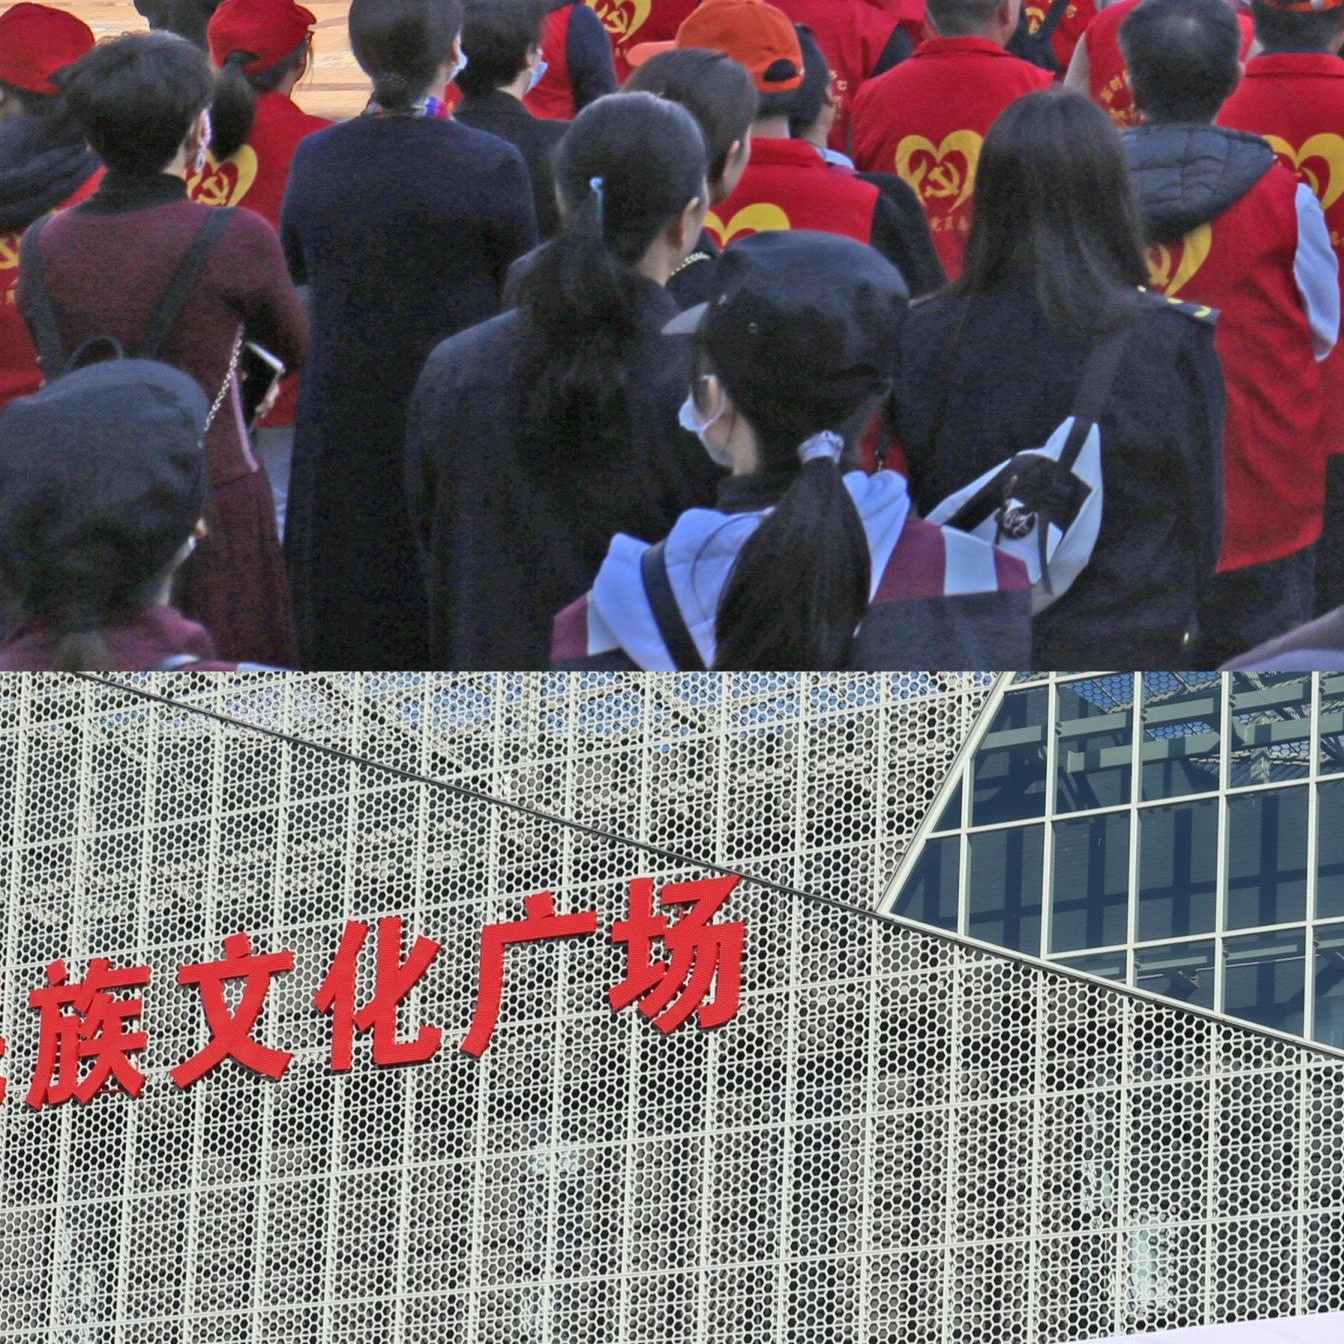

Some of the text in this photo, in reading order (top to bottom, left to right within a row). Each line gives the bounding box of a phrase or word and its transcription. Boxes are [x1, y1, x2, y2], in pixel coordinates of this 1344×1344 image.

[0, 874, 746, 1111] 族文化广场
